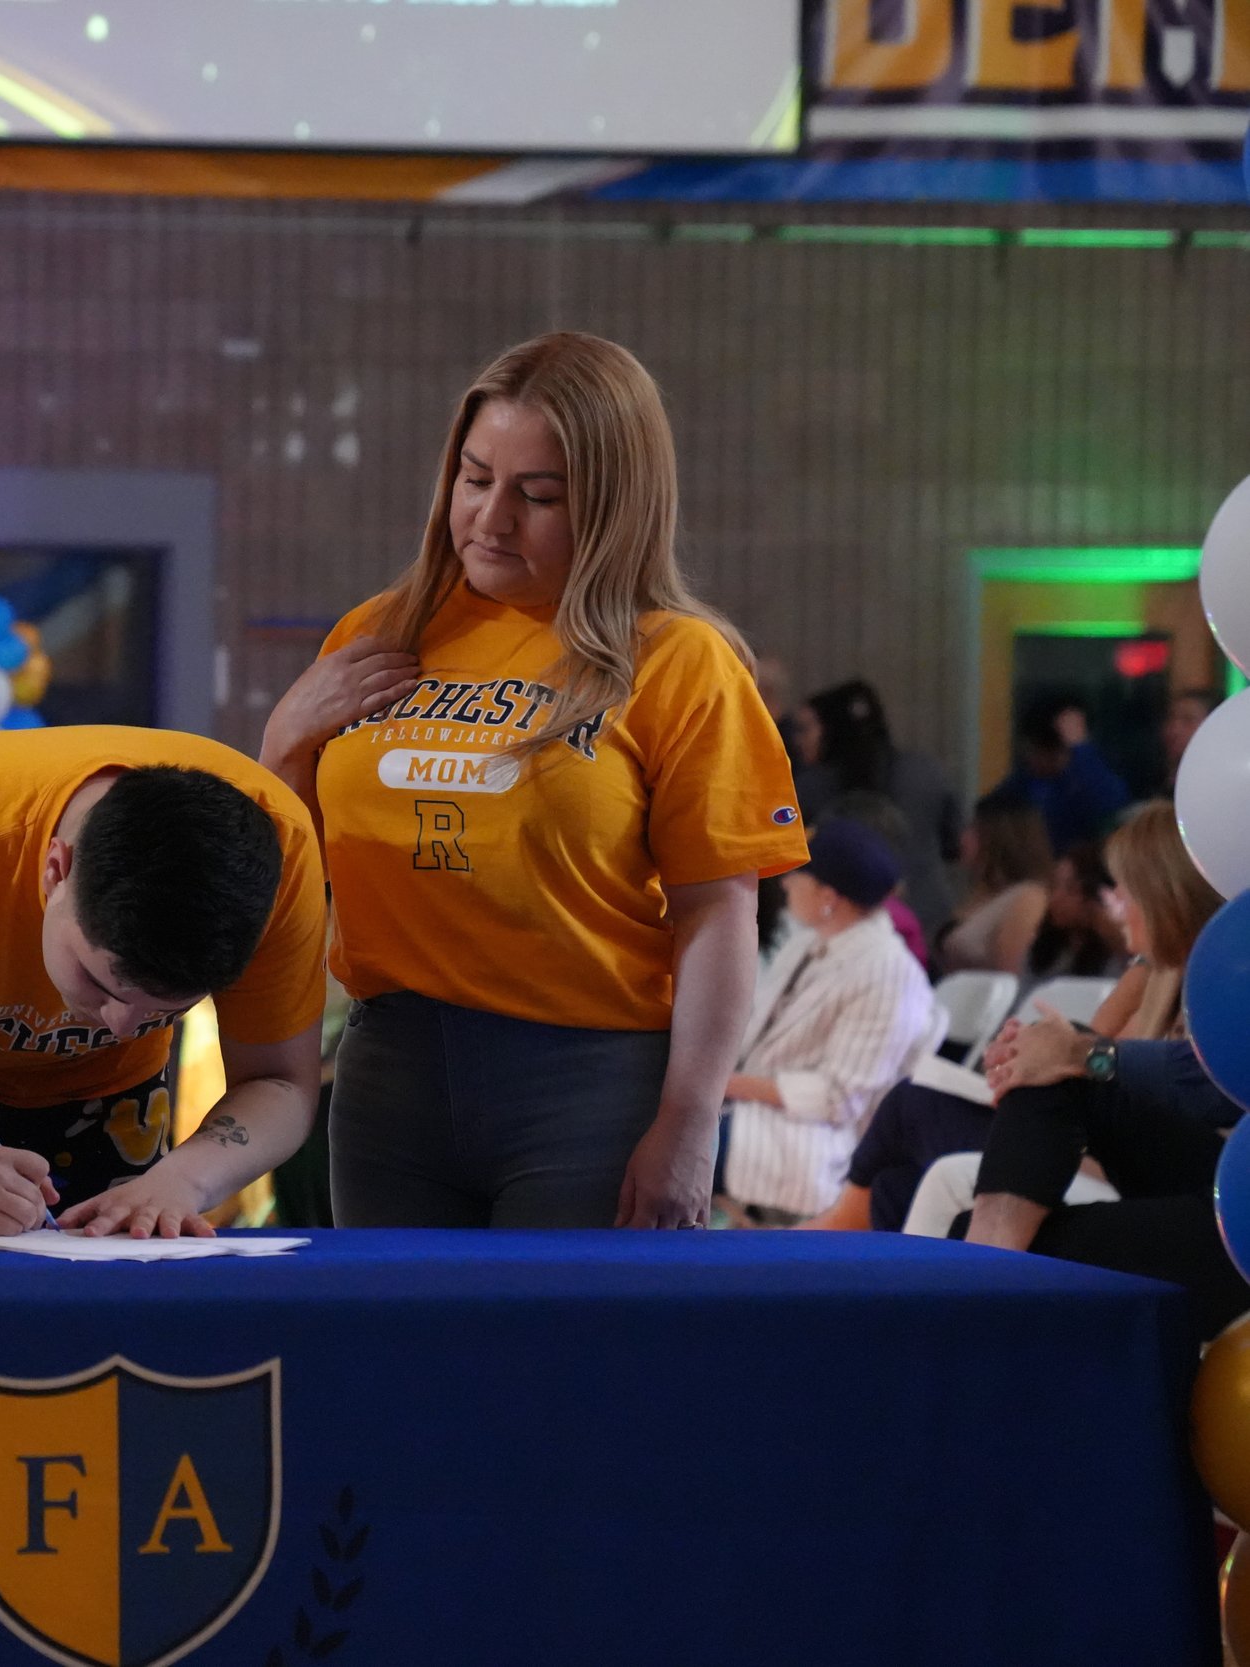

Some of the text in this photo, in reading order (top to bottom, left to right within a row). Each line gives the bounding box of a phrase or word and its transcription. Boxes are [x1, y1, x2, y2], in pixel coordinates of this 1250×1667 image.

[370, 725, 529, 746] YELLOWJACKE
[405, 756, 490, 786] MOM
[413, 799, 470, 872] R
[16, 1452, 234, 1555] F A
